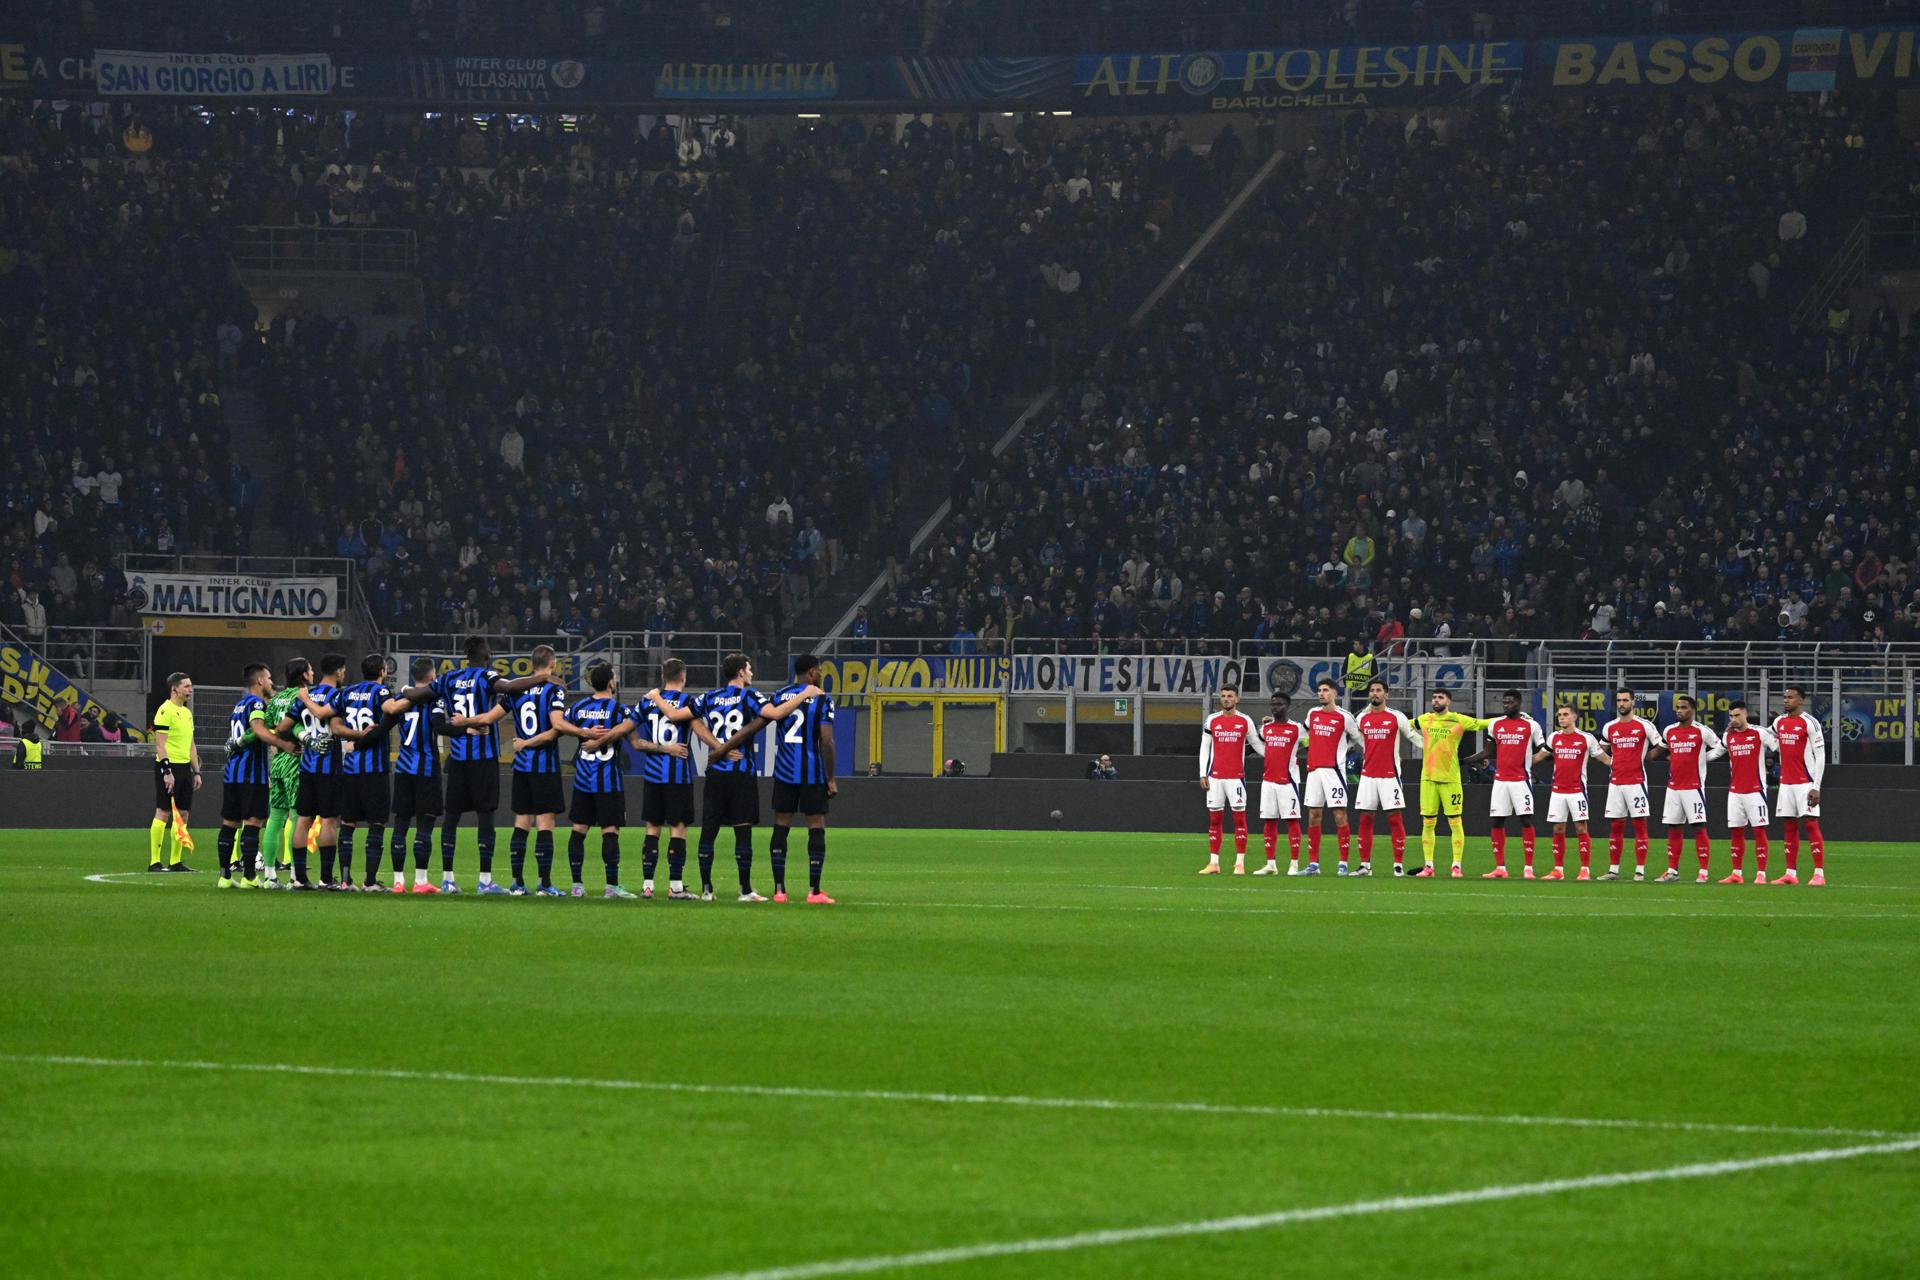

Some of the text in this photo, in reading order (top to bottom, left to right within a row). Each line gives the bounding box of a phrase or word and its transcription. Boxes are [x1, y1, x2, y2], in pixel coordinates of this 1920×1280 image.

[169, 55, 256, 64] INTER CLUB
[456, 57, 547, 70] INTER CLUB
[1552, 31, 1920, 86] BASSO VI
[59, 58, 95, 80] CH
[1242, 42, 1510, 92] POLESINE
[100, 62, 328, 93] SAN GIORGIO A LIRI
[456, 71, 546, 89] VILLASANTA
[659, 62, 837, 91] ALTOLIVENZA
[1212, 92, 1368, 109] BARUCHELLA
[210, 577, 272, 587] INTER CLUB
[152, 584, 328, 616] MALTIGNANO
[794, 658, 931, 707] ORMIO
[1014, 657, 1242, 693] MONTESILVANO
[453, 693, 476, 718] 31
[1633, 707, 1655, 718] OLO
[345, 706, 375, 731] 36
[520, 701, 538, 735] 6
[784, 708, 805, 743] 2
[404, 712, 419, 746] 7
[648, 713, 679, 745] 16
[709, 708, 744, 744] 28
[1612, 736, 1640, 744] Emirates
[1670, 741, 1696, 749] Emirates
[1555, 747, 1582, 755] Emirates
[1236, 786, 1242, 798] 4
[1331, 787, 1344, 799] 29
[1393, 788, 1400, 800] 2
[1451, 793, 1462, 806] 22
[1291, 798, 1296, 810] 7
[1524, 794, 1530, 806] 5
[1577, 800, 1587, 812] 19
[1634, 796, 1647, 809] 23
[1693, 802, 1704, 814] 12
[1758, 805, 1766, 817] 11
